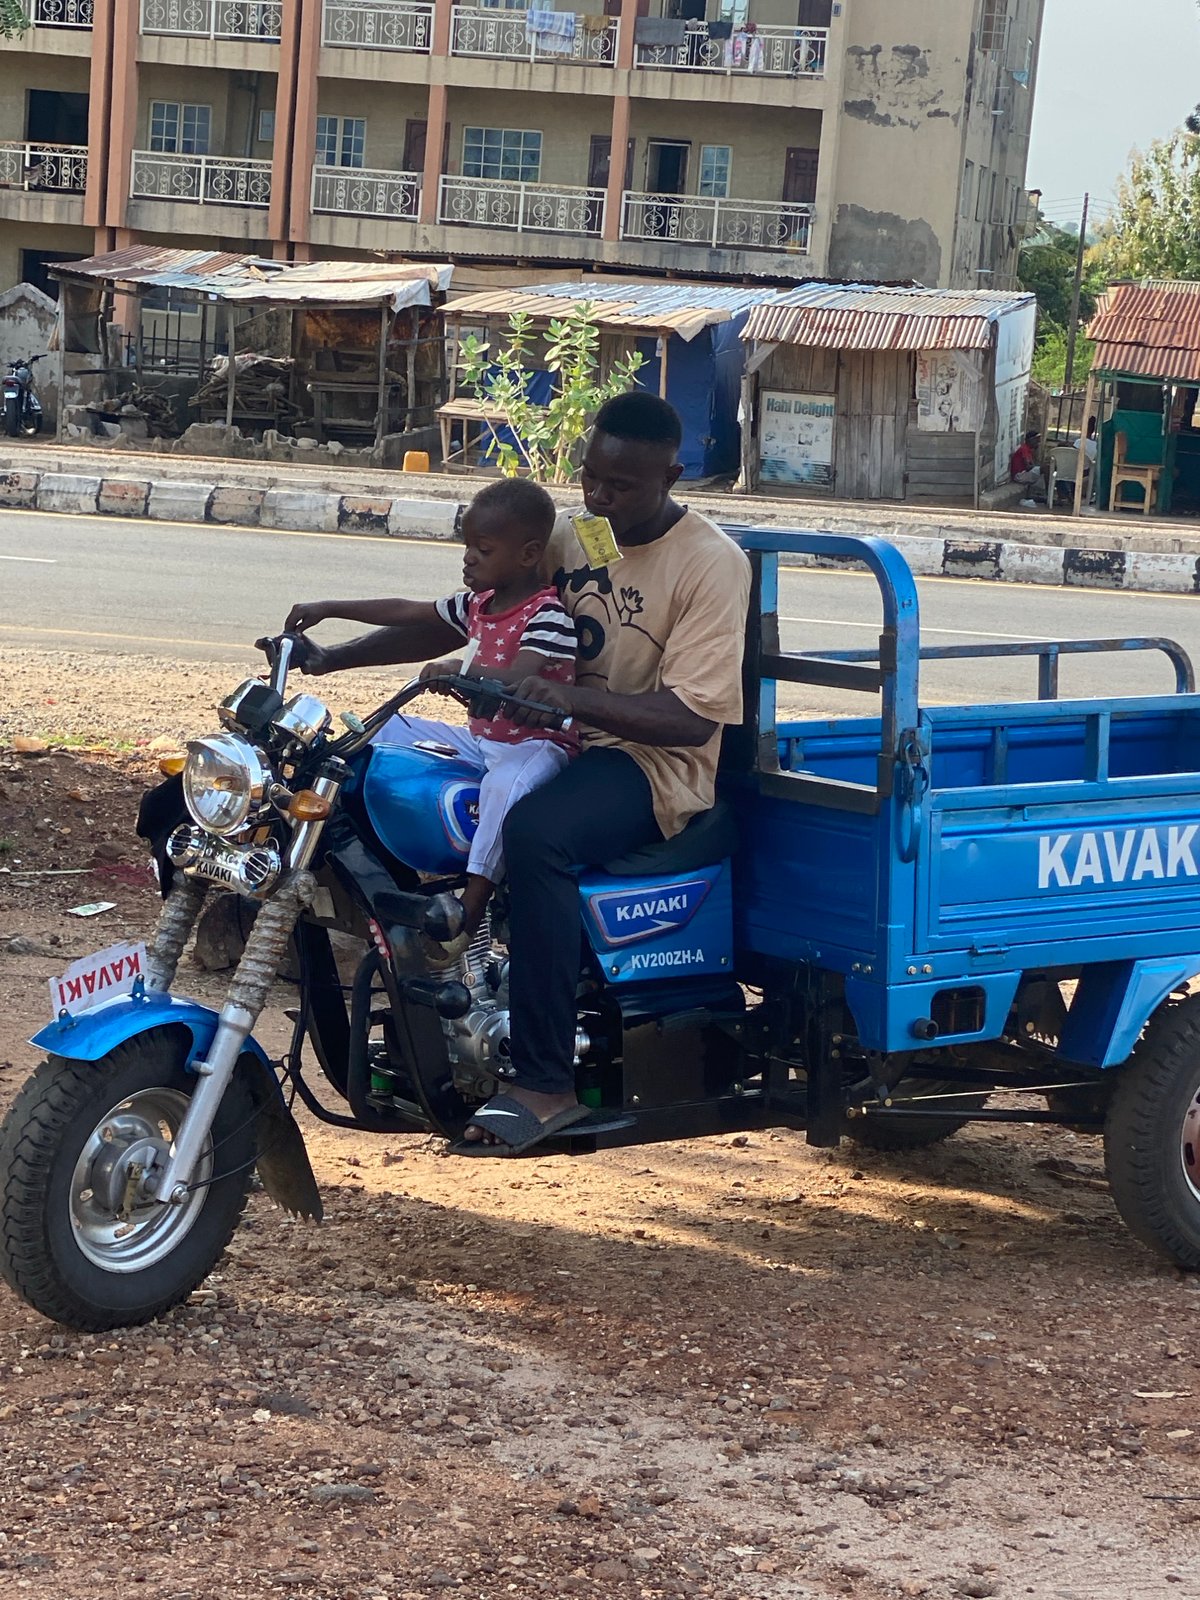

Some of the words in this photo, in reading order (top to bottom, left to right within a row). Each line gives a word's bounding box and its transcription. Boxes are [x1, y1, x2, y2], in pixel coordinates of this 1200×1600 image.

[767, 397, 792, 413] Habi
[794, 400, 835, 417] Delight
[1038, 825, 1199, 888] KAVAK
[196, 861, 233, 882] KAVAKI
[616, 894, 688, 921] KAVAKI
[631, 948, 705, 969] KV200ZH-A
[58, 952, 141, 1006] KAVAKI
